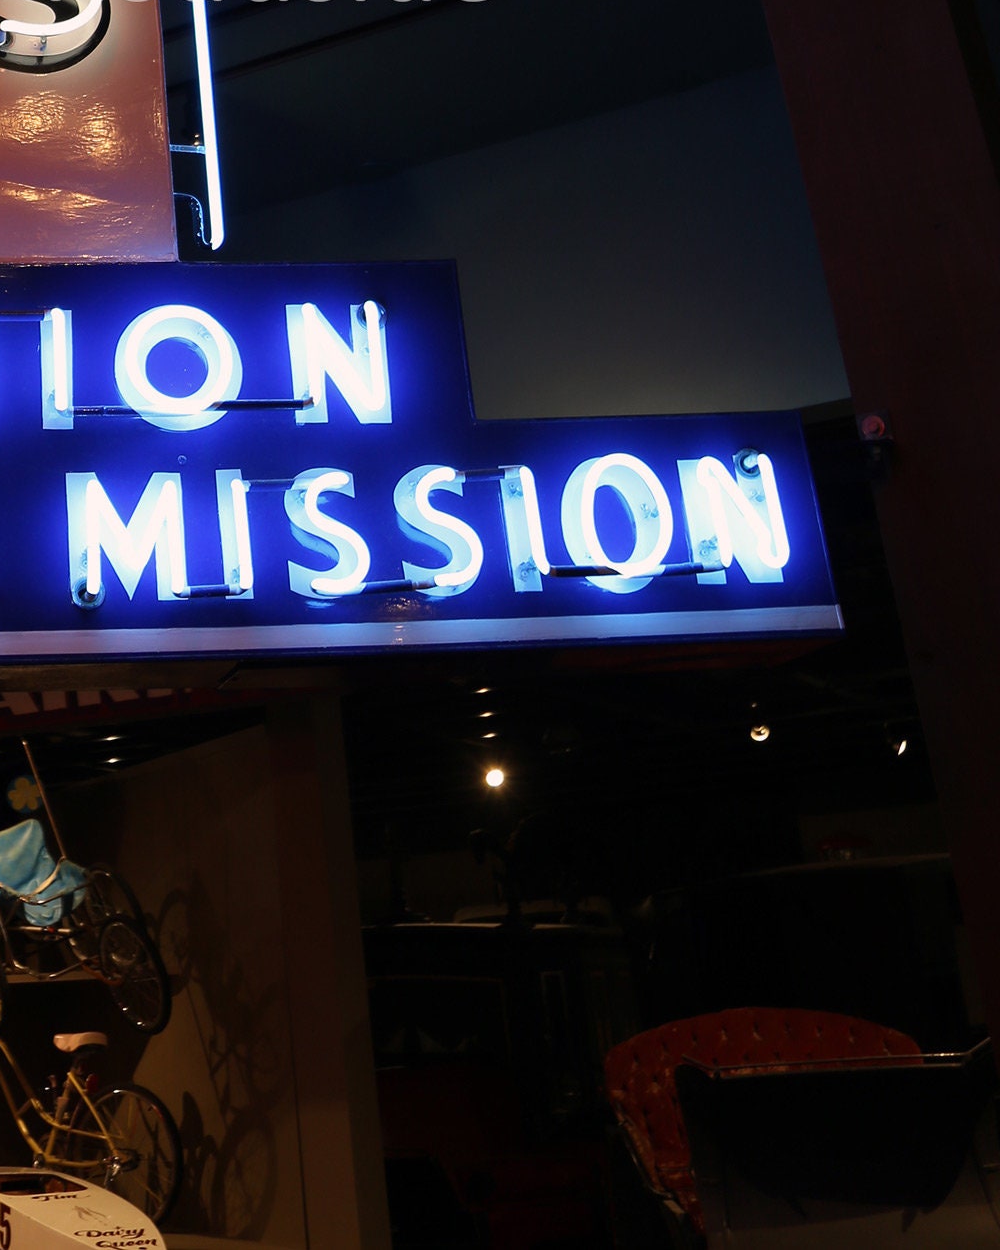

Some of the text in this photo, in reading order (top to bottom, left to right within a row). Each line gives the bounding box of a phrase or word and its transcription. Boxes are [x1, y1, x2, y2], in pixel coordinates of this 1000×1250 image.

[66, 453, 791, 606] MISSION
[74, 1226, 145, 1239] Dairy
[96, 1236, 158, 1250] Queen
